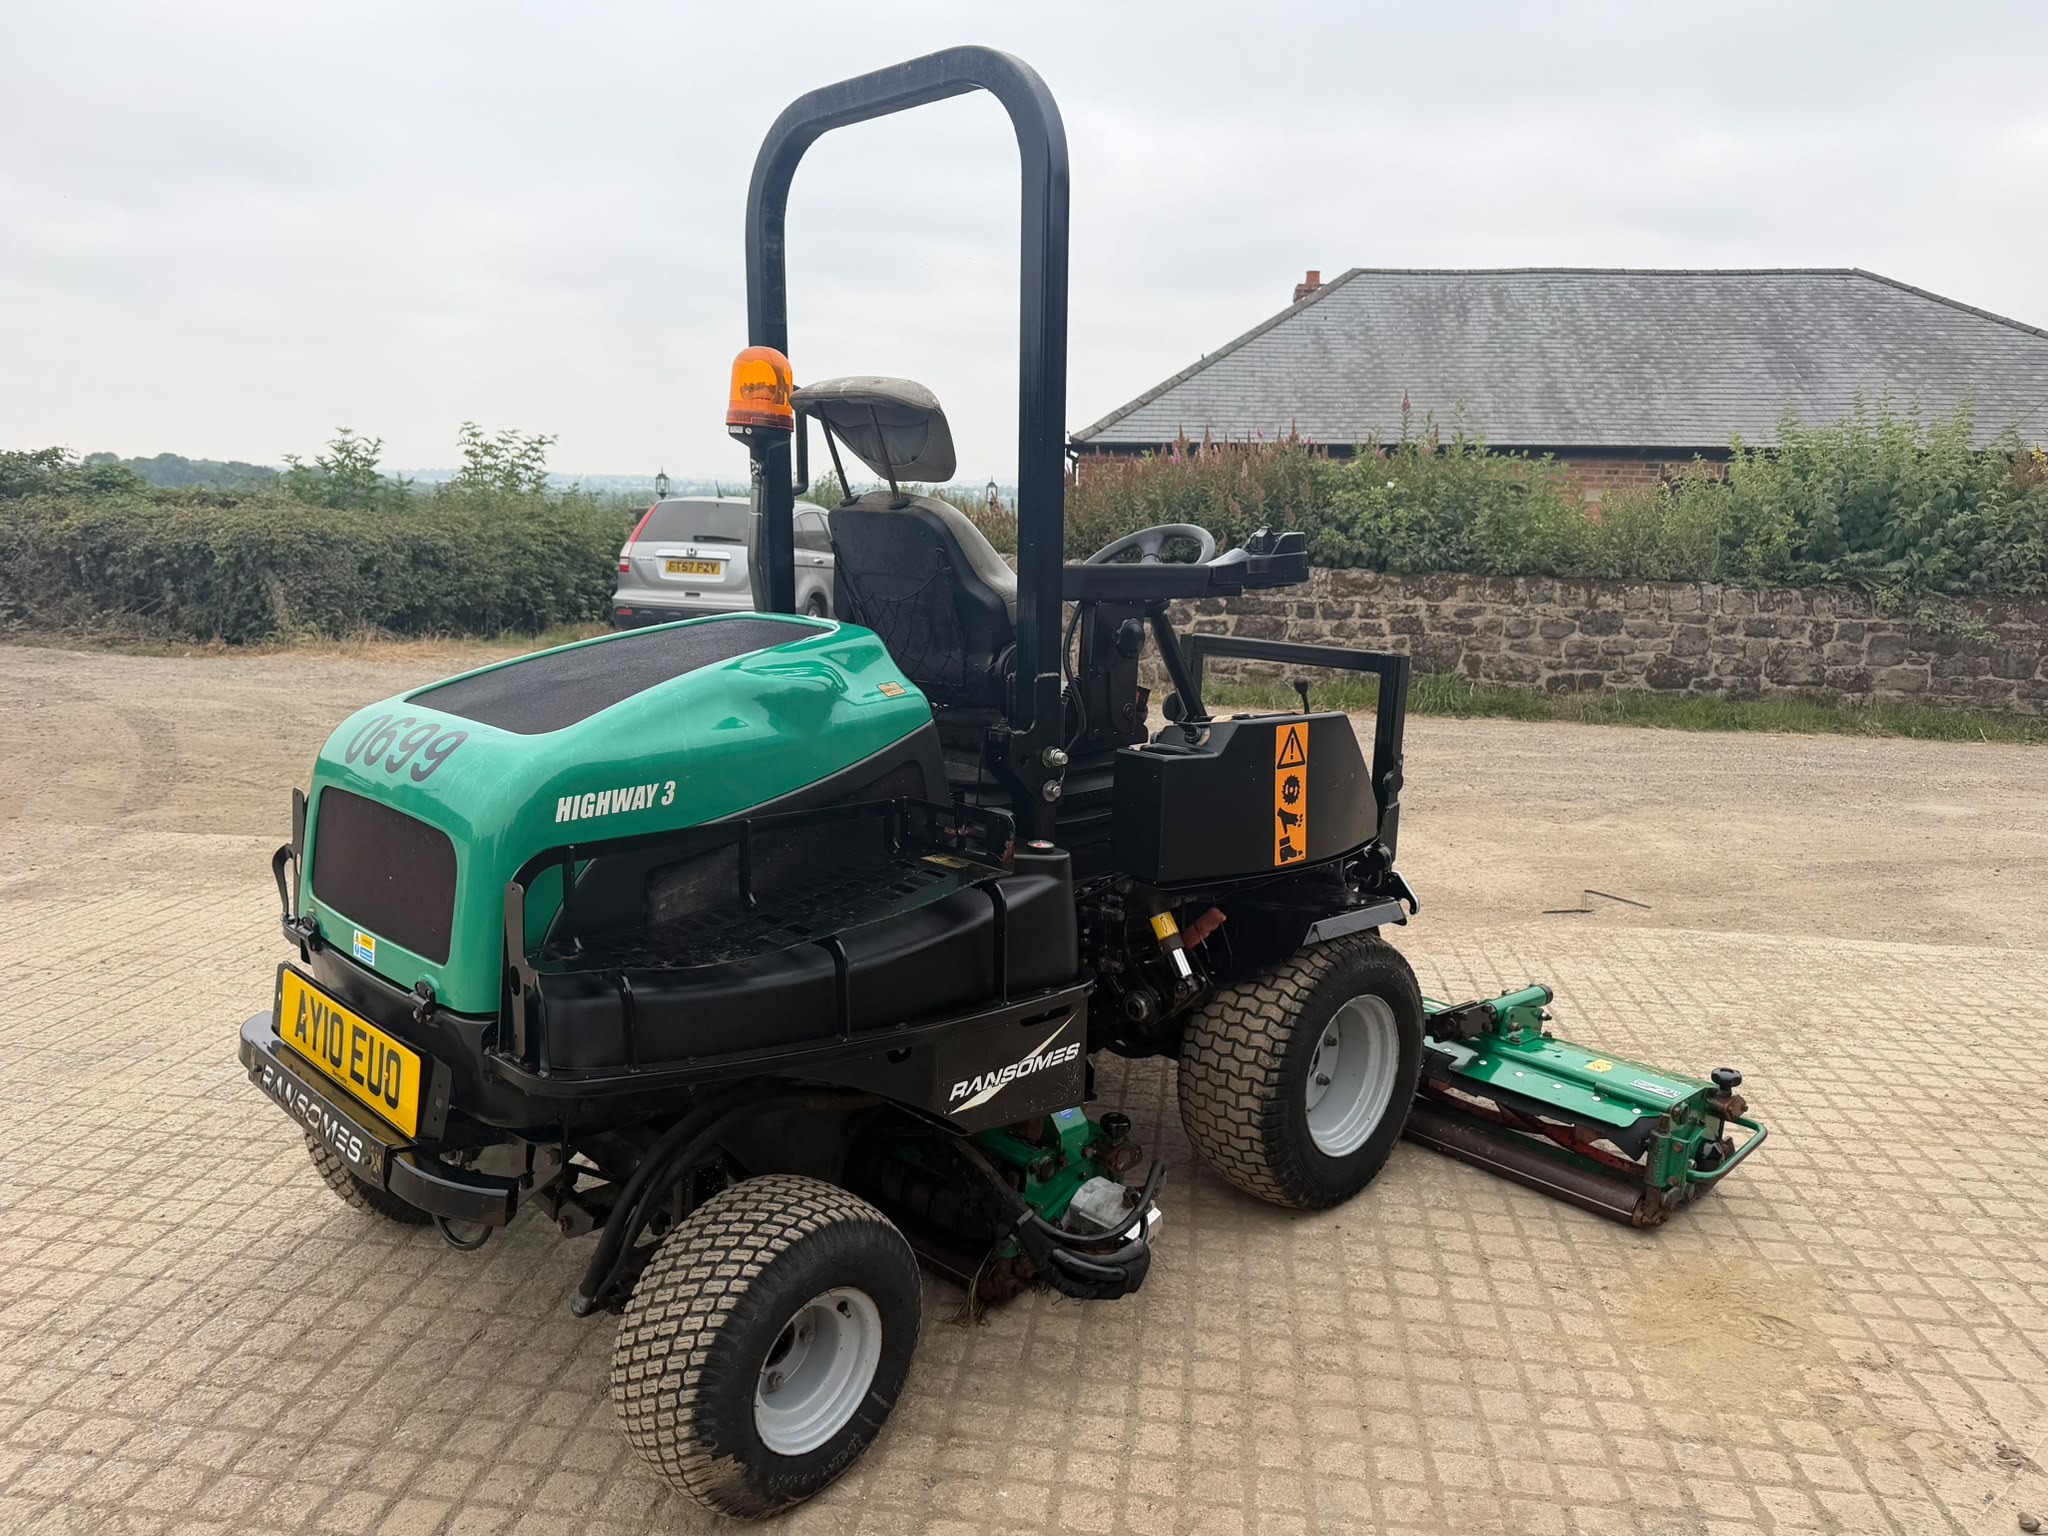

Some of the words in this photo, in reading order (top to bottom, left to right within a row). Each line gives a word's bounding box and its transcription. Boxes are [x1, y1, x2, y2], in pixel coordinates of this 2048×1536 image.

[669, 560, 695, 573] FT57
[697, 561, 717, 574] FZV
[345, 714, 469, 782] 0699
[555, 783, 659, 823] HIGHWAY
[661, 781, 676, 806] 3
[294, 989, 345, 1069] AY10
[349, 1027, 402, 1110] EUO
[948, 1042, 1081, 1102] RANSOMES
[261, 1063, 363, 1164] RANSOMES
